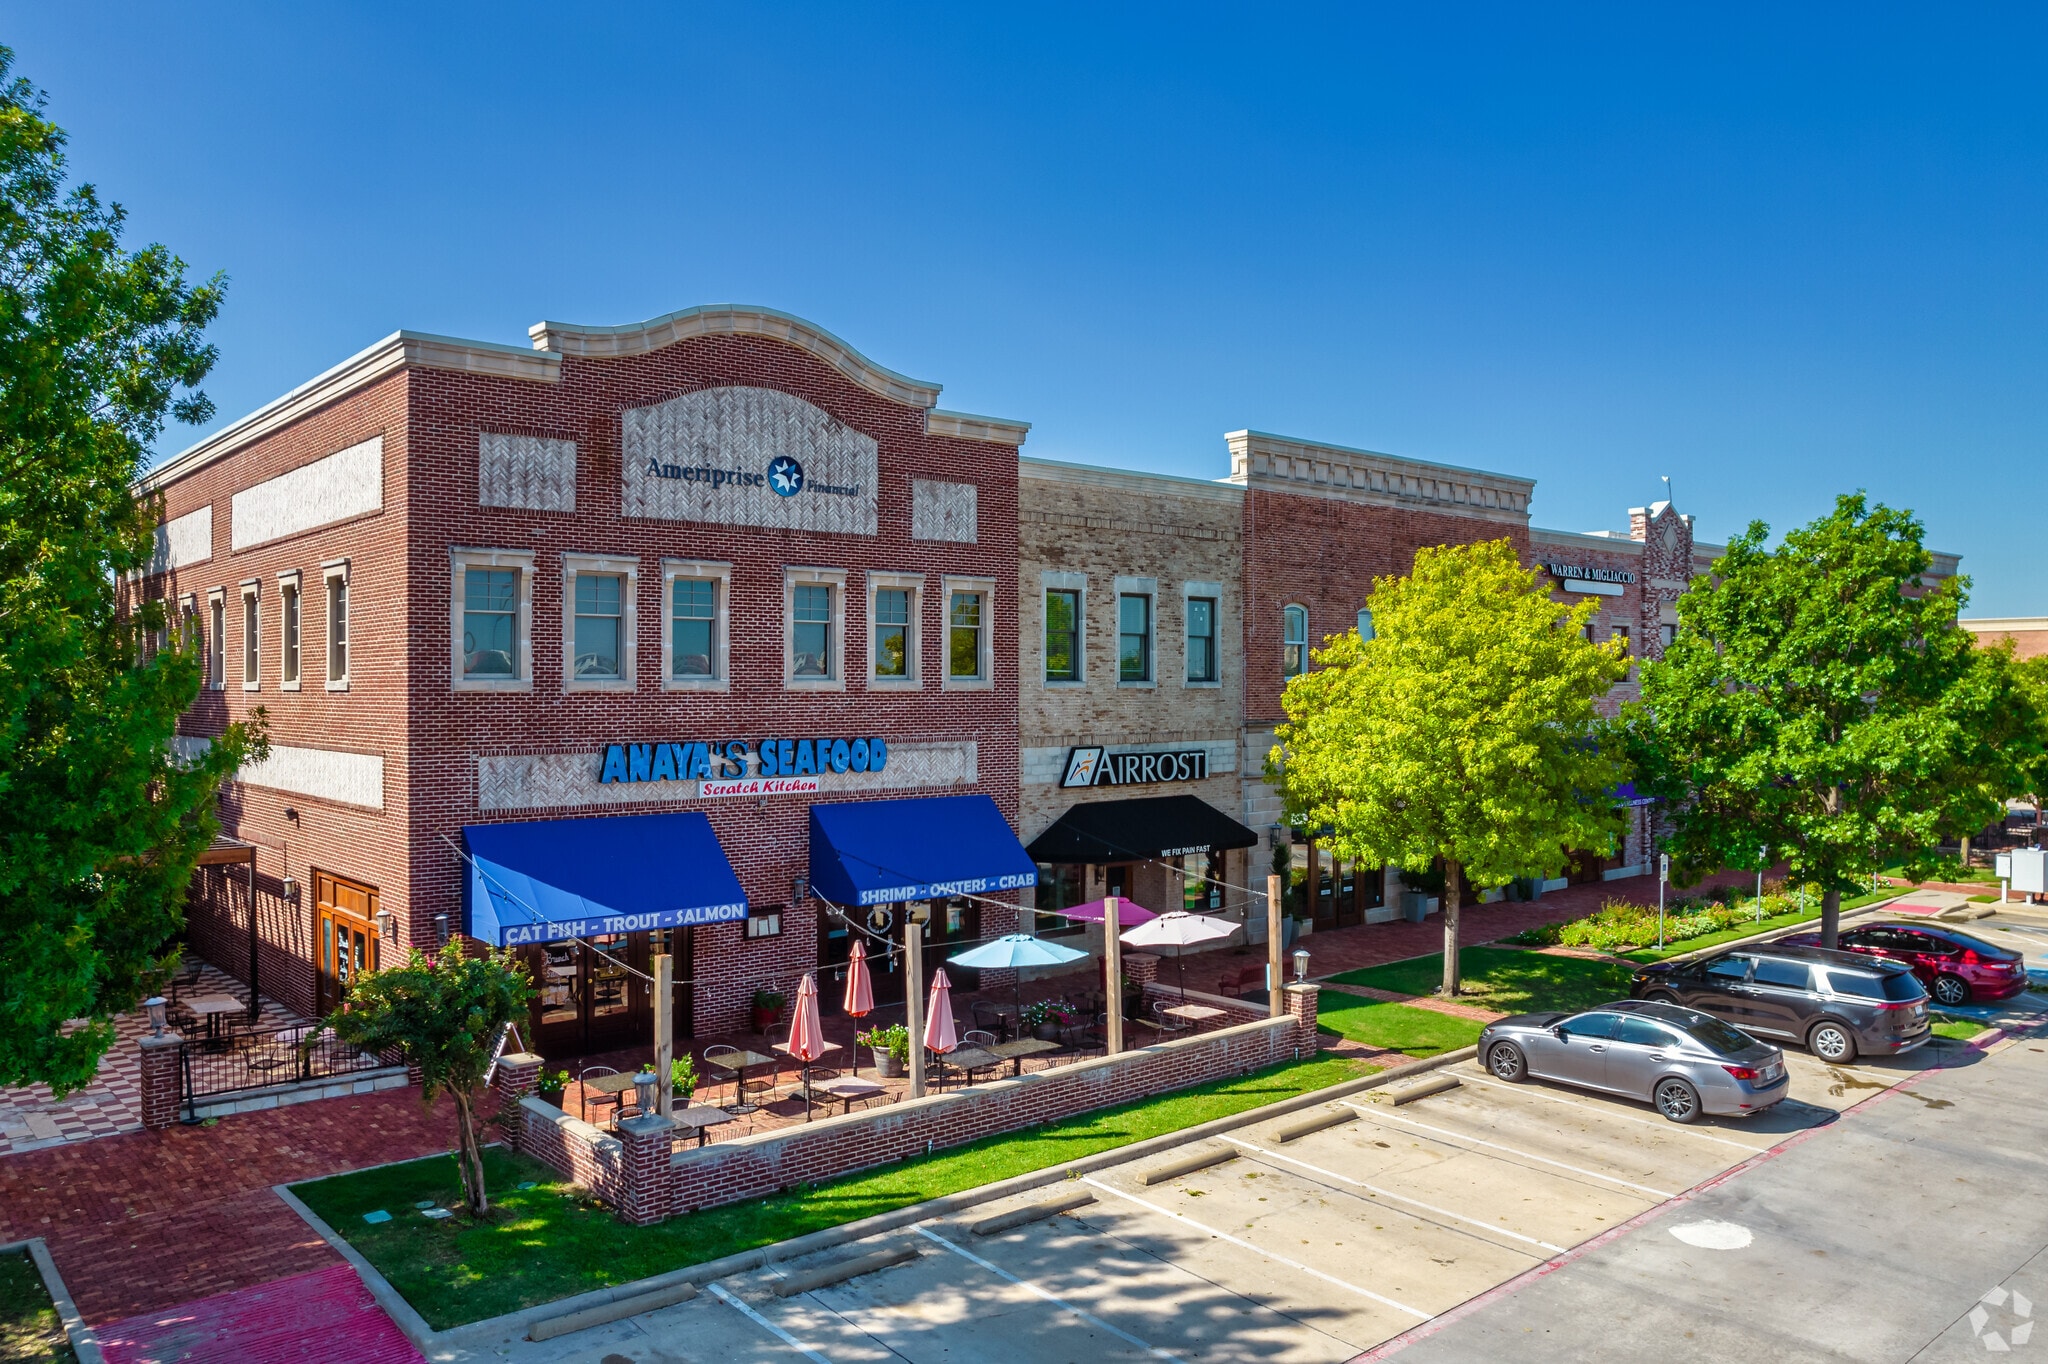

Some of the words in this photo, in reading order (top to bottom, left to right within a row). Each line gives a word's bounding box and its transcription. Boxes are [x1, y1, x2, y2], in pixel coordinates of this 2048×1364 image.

[647, 458, 765, 489] Ameriprise
[807, 480, 860, 497] Financial
[1551, 563, 1583, 578] WARREN
[1584, 568, 1591, 579] &
[1592, 568, 1636, 583] MIGLIACCIO
[600, 740, 749, 784] ANAYA'S
[758, 737, 887, 776] SEAFOOD
[1093, 750, 1209, 786] AIRROSTI
[703, 780, 759, 796] Scratch
[763, 776, 817, 793] Kitchen
[1161, 849, 1171, 857] WE
[1171, 848, 1181, 856] FIX
[1182, 846, 1195, 854] PAIN
[1196, 844, 1211, 853] FAST
[861, 886, 916, 904] SHRIMP
[930, 878, 986, 896] OYSTERS
[999, 873, 1035, 888] CRAB
[505, 926, 543, 944] CAT
[547, 920, 587, 939] FISH
[603, 912, 661, 933] TROUT
[676, 904, 745, 926] SALMON
